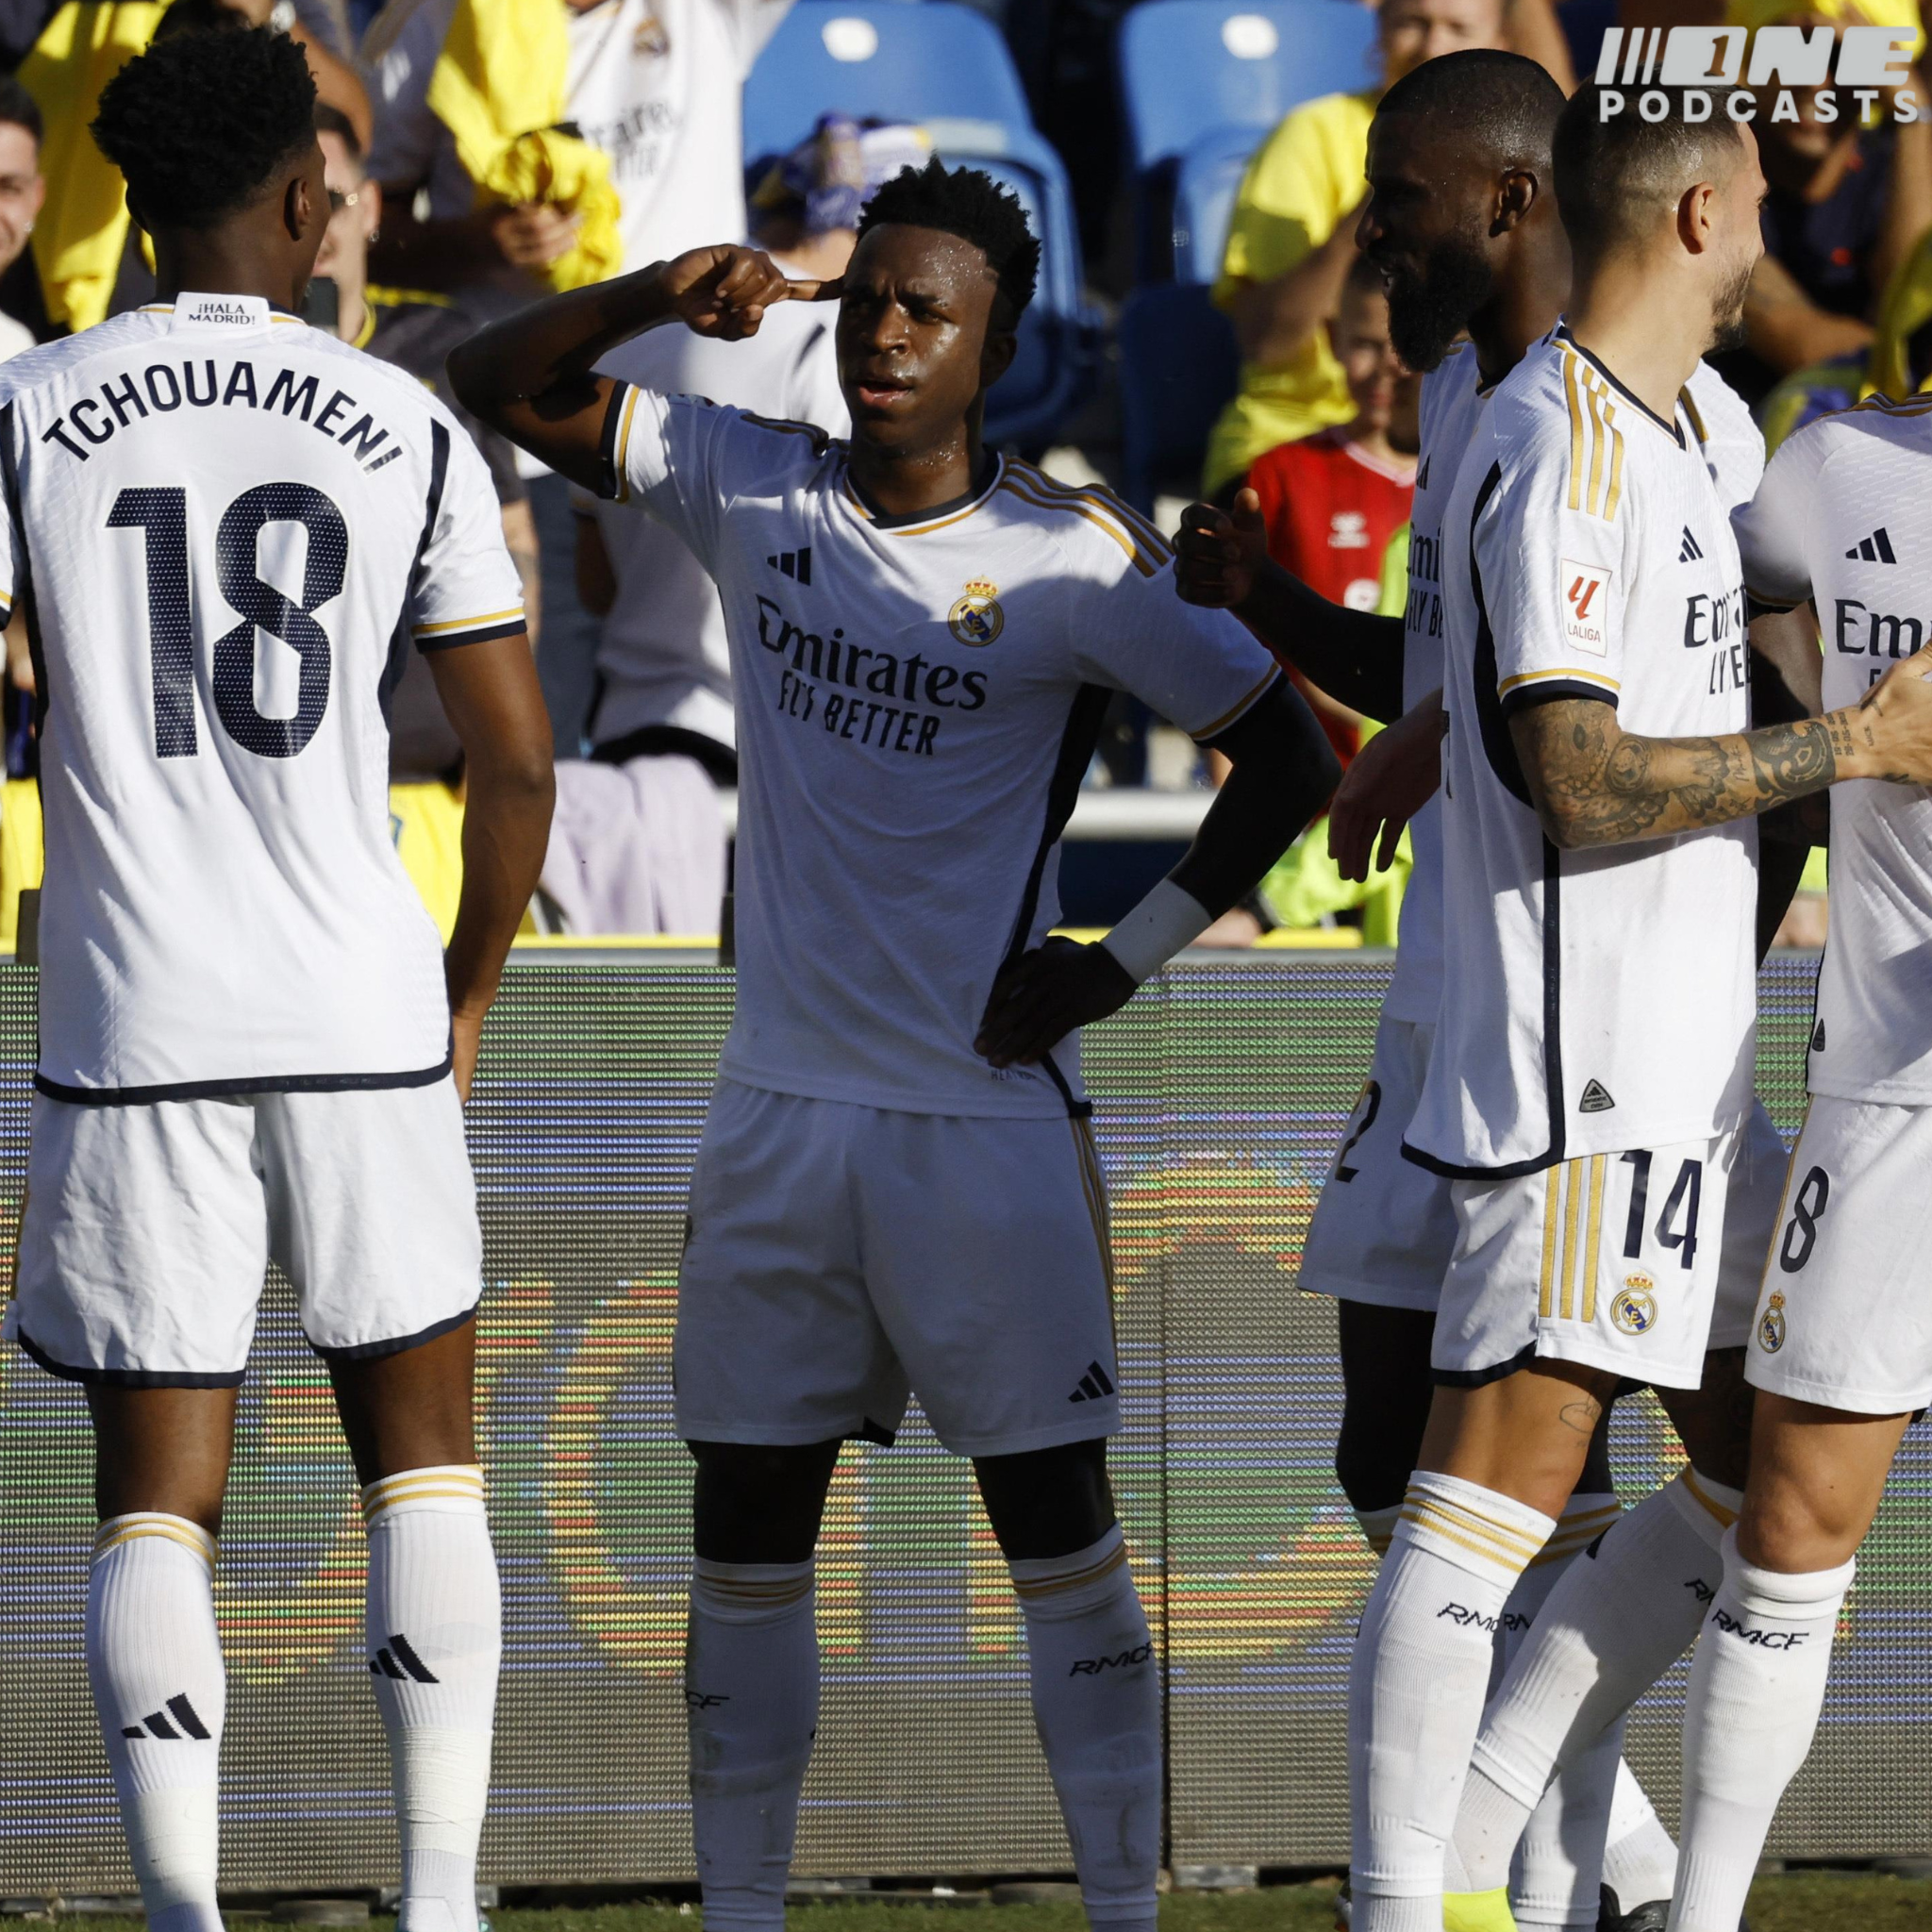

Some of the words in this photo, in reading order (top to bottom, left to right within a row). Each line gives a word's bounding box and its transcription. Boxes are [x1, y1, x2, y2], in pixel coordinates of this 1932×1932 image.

[188, 314, 256, 325] MADRID!
[42, 359, 403, 476] TCHOUAMENI
[105, 482, 349, 758] 18
[755, 593, 988, 710] Emirates
[1567, 622, 1601, 642] LALIGA
[1834, 597, 1932, 659] Em
[824, 693, 941, 756] BETTER
[1619, 1149, 1703, 1270] 14
[1780, 1165, 1829, 1274] 8
[1437, 1602, 1499, 1633] RMC
[1711, 1607, 1810, 1651] RMCF
